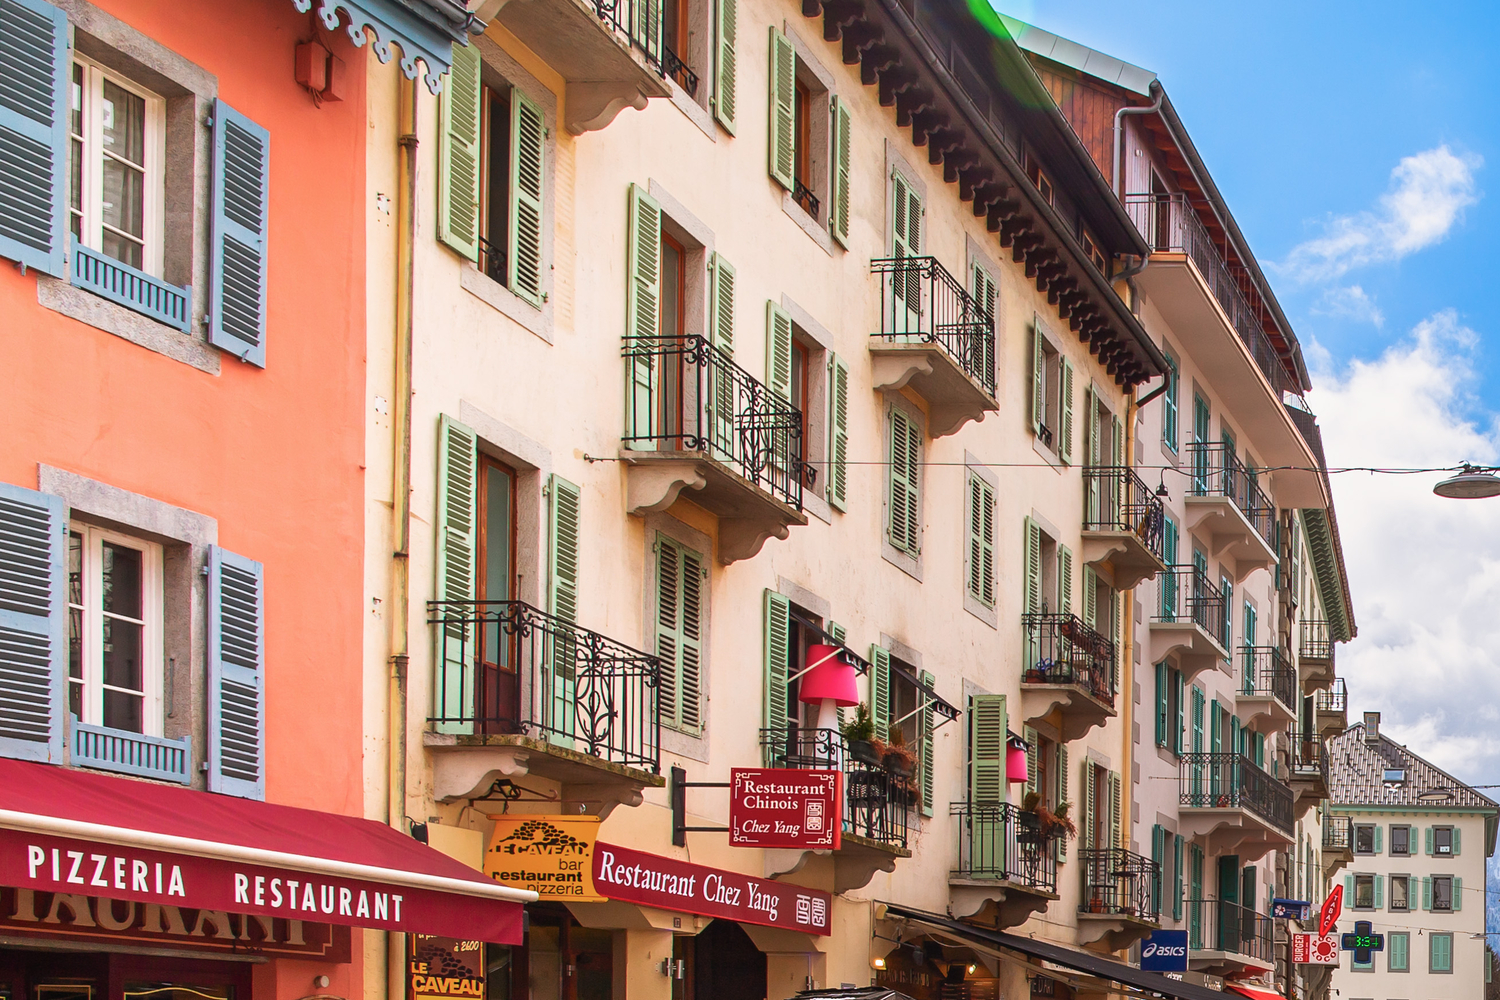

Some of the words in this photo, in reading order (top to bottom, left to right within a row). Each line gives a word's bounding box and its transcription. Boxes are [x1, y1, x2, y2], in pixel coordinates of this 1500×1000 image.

[744, 780, 826, 795] Restaurant
[743, 795, 799, 810] Chinois
[742, 819, 771, 833] Chez
[773, 820, 801, 838] Yang
[559, 858, 584, 871] bar
[27, 844, 186, 897] PIZZERIA
[233, 872, 404, 922] RESTAURANT
[492, 870, 583, 882] restaurant
[527, 882, 584, 895] pizzeria
[598, 850, 696, 898] Restaurant
[703, 873, 741, 907] Chez
[747, 881, 780, 922] Yang
[1323, 895, 1339, 927] TABAC
[1295, 934, 1304, 962] BURGER
[411, 961, 428, 975] LE
[411, 975, 484, 996] CAVEAU
